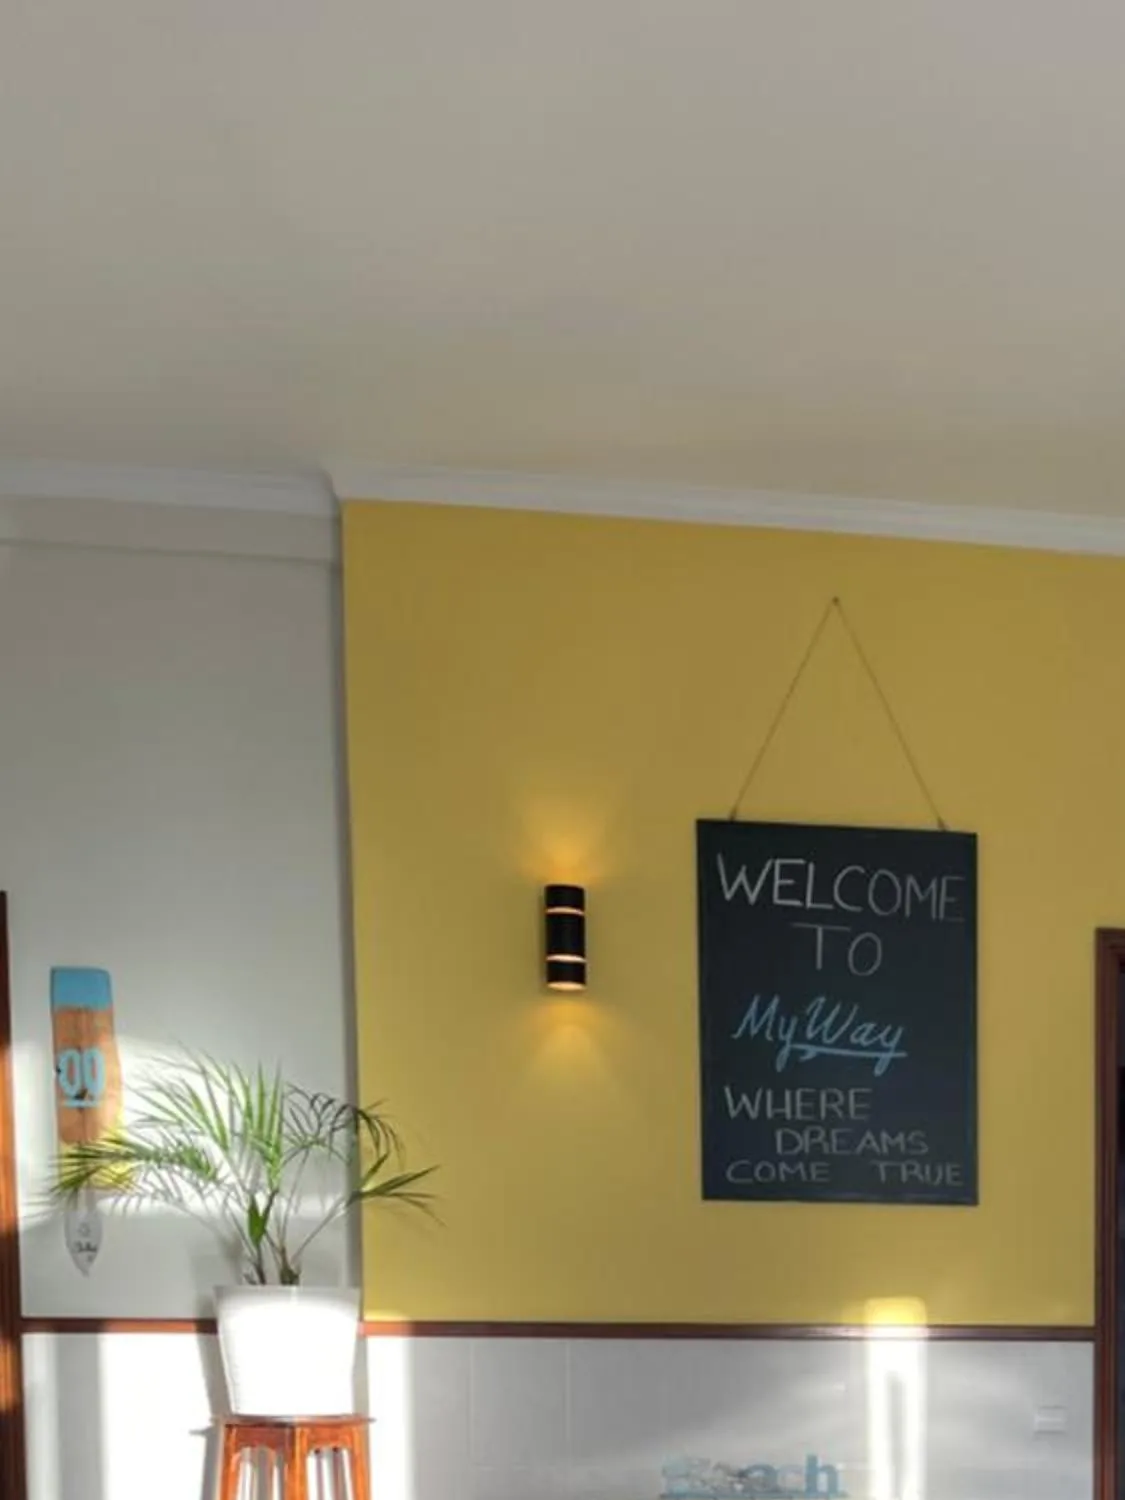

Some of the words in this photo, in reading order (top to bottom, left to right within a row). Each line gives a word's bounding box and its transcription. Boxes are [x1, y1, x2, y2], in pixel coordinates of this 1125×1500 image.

[716, 852, 965, 923] WELCOME
[790, 921, 882, 977] TO
[723, 1085, 873, 1121] WHERE
[774, 1125, 929, 1156] DREAMS
[725, 1159, 831, 1184] COME
[870, 1159, 964, 1187] TRUE
